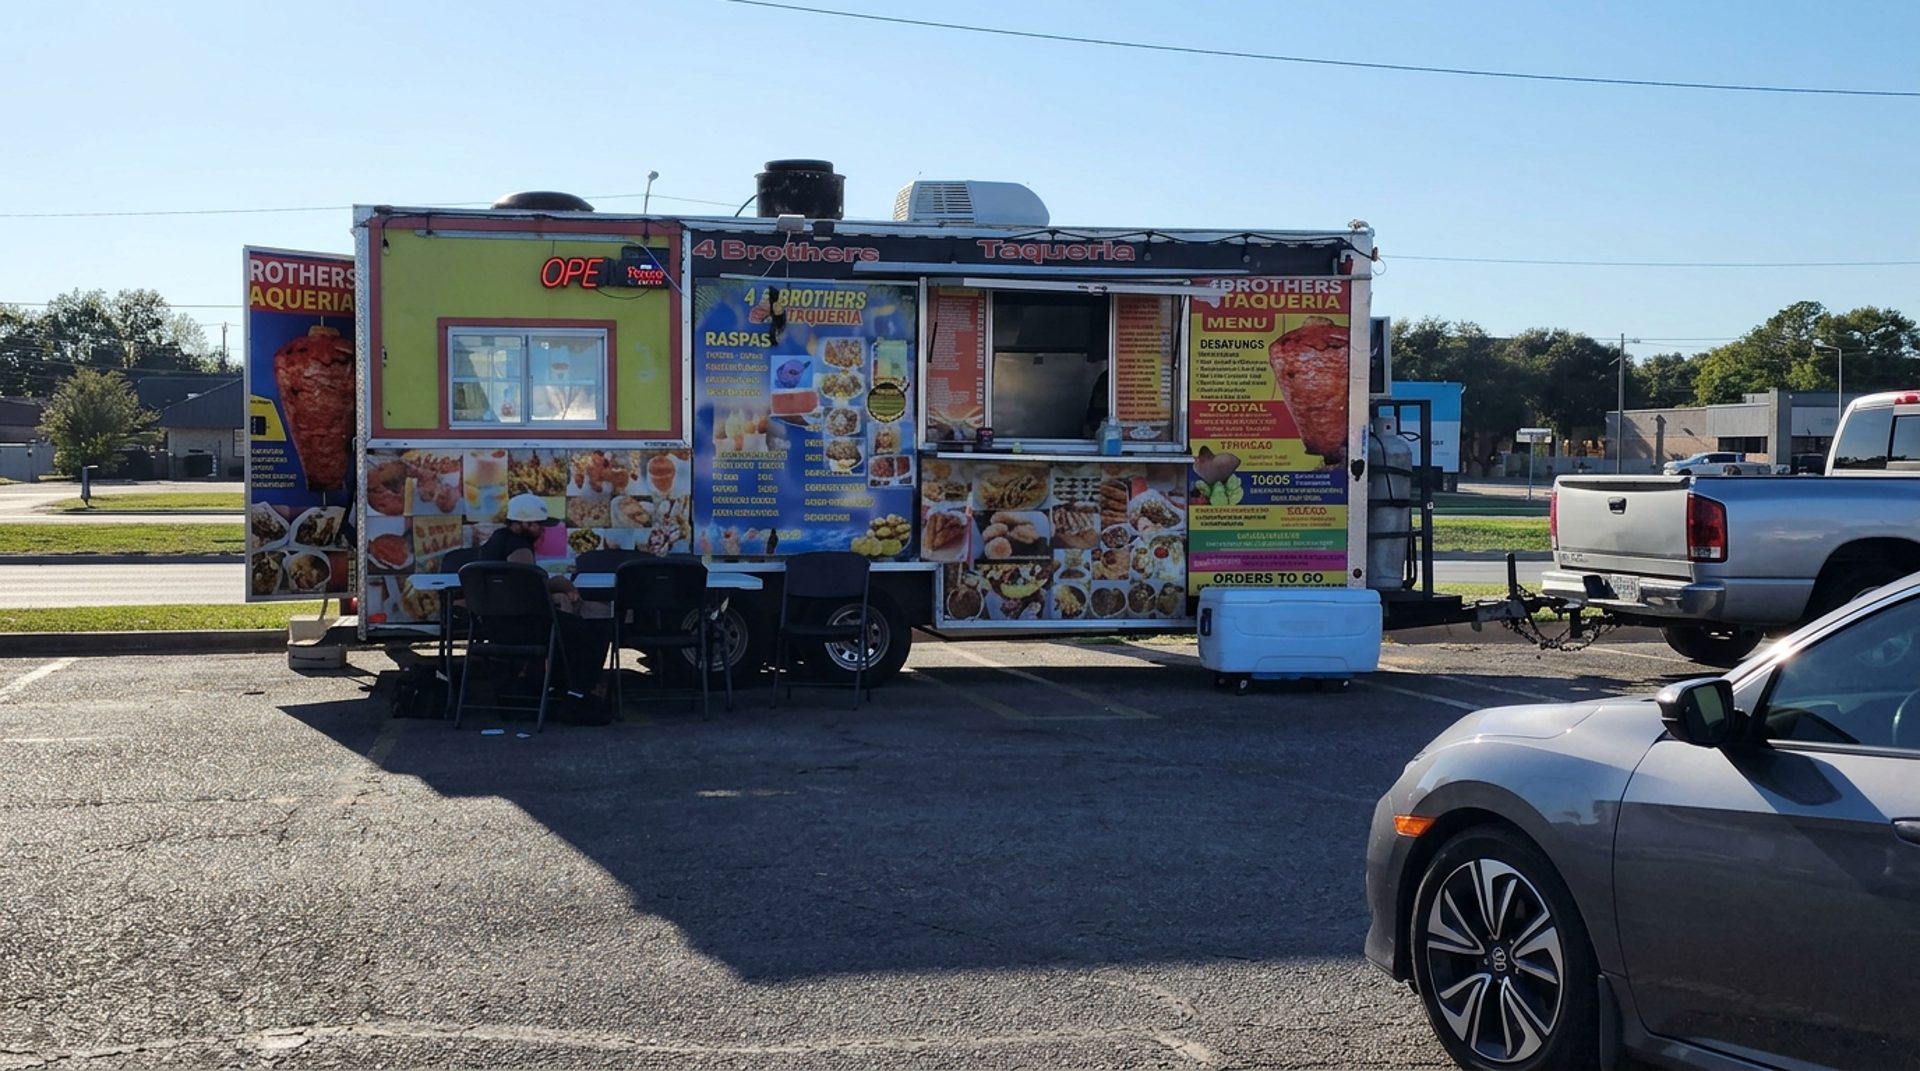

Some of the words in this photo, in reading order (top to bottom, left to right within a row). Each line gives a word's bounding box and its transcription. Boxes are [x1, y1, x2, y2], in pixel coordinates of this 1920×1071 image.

[693, 240, 716, 259] 4
[721, 240, 880, 262] Brothers
[977, 240, 1136, 264] Taqueria
[250, 259, 355, 289] ROTHERS
[250, 285, 354, 312] AQUERIA
[779, 288, 867, 309] BROTHERS
[1222, 293, 1342, 310] TAQUERIA
[1207, 316, 1268, 329] MENU
[705, 331, 772, 348] RASPAS
[1213, 572, 1274, 584] ORDERS
[1278, 572, 1298, 584] TO
[1302, 572, 1324, 584] GO
